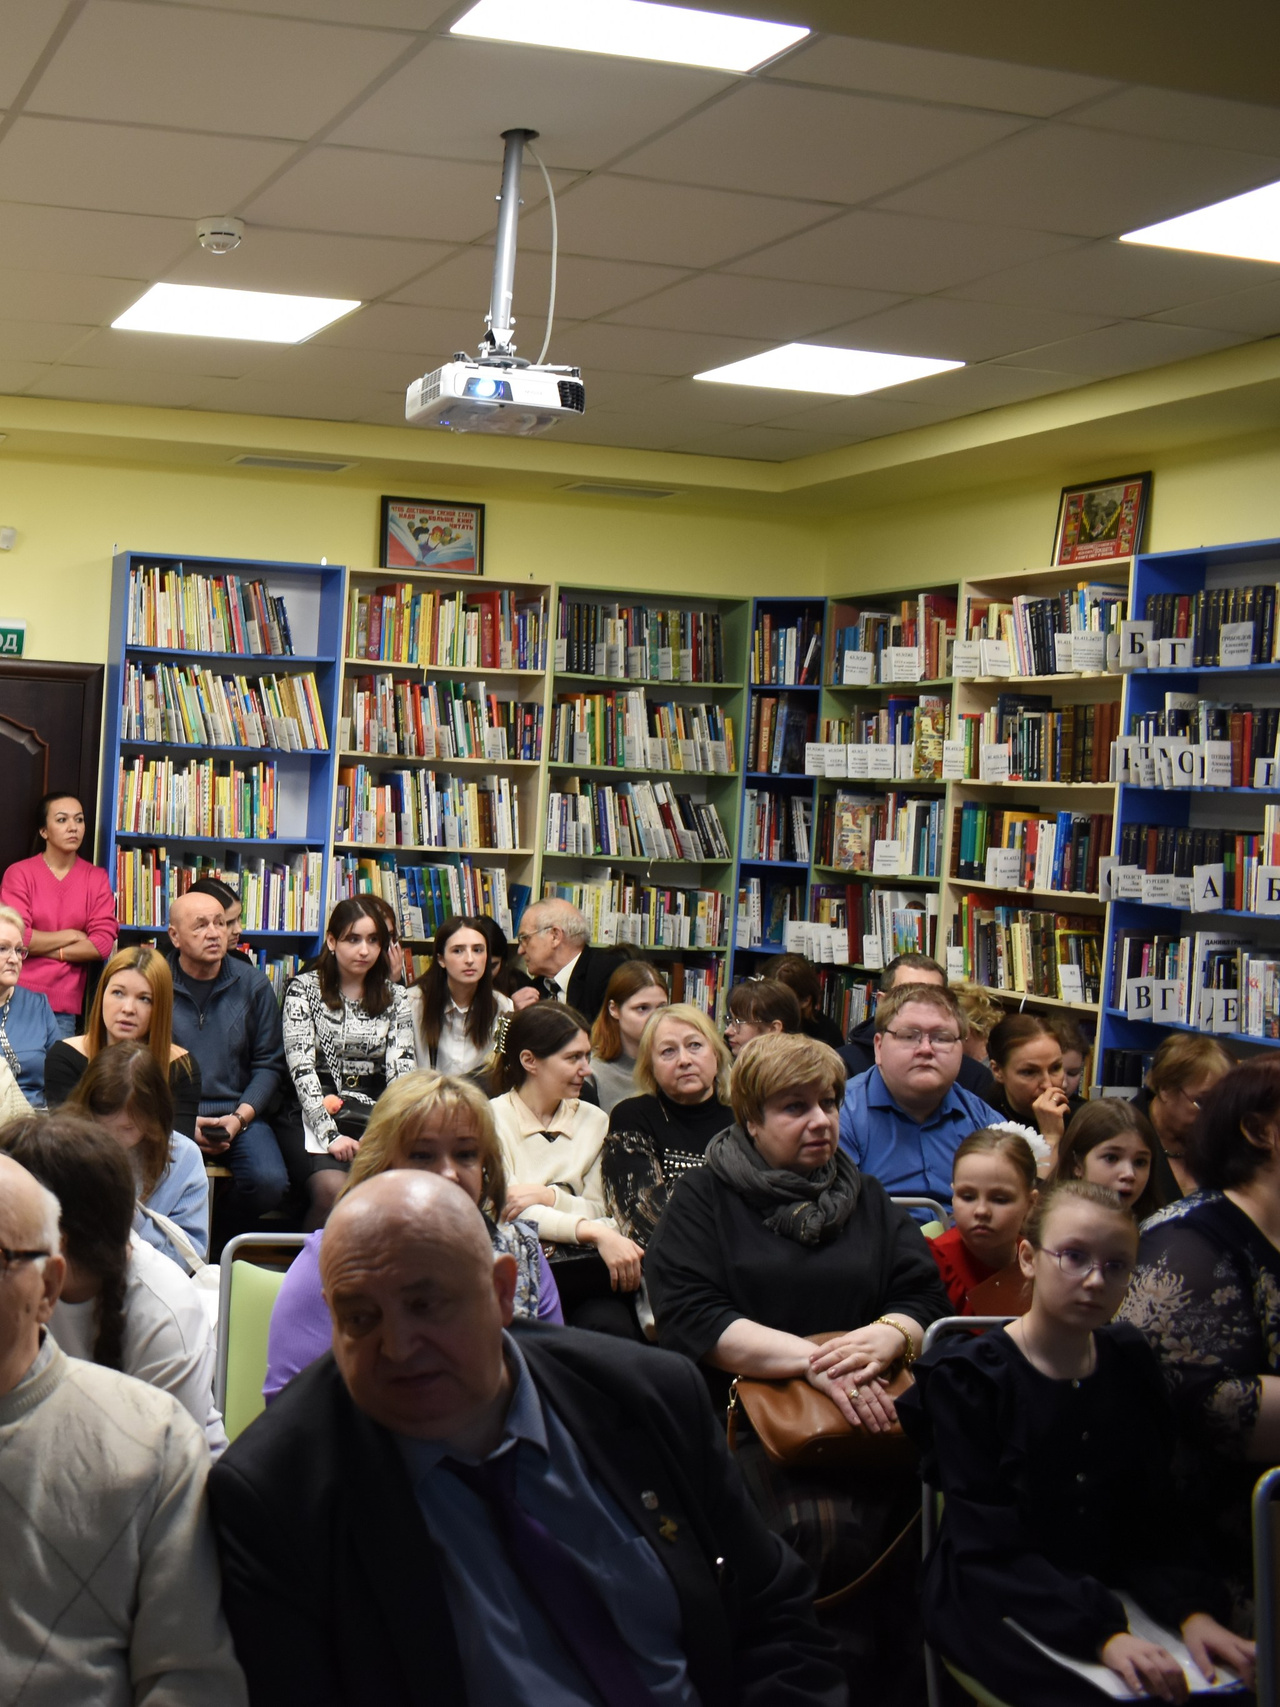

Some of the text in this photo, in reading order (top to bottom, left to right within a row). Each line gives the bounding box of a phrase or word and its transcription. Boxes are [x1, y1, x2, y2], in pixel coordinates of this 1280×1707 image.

[428, 515, 454, 523] БОЛЬШЕ
[1129, 632, 1145, 654] Б
[1169, 643, 1186, 665] Г
[1203, 876, 1219, 898] А
[1135, 986, 1174, 1010] В Г
[1223, 998, 1237, 1022] Е
